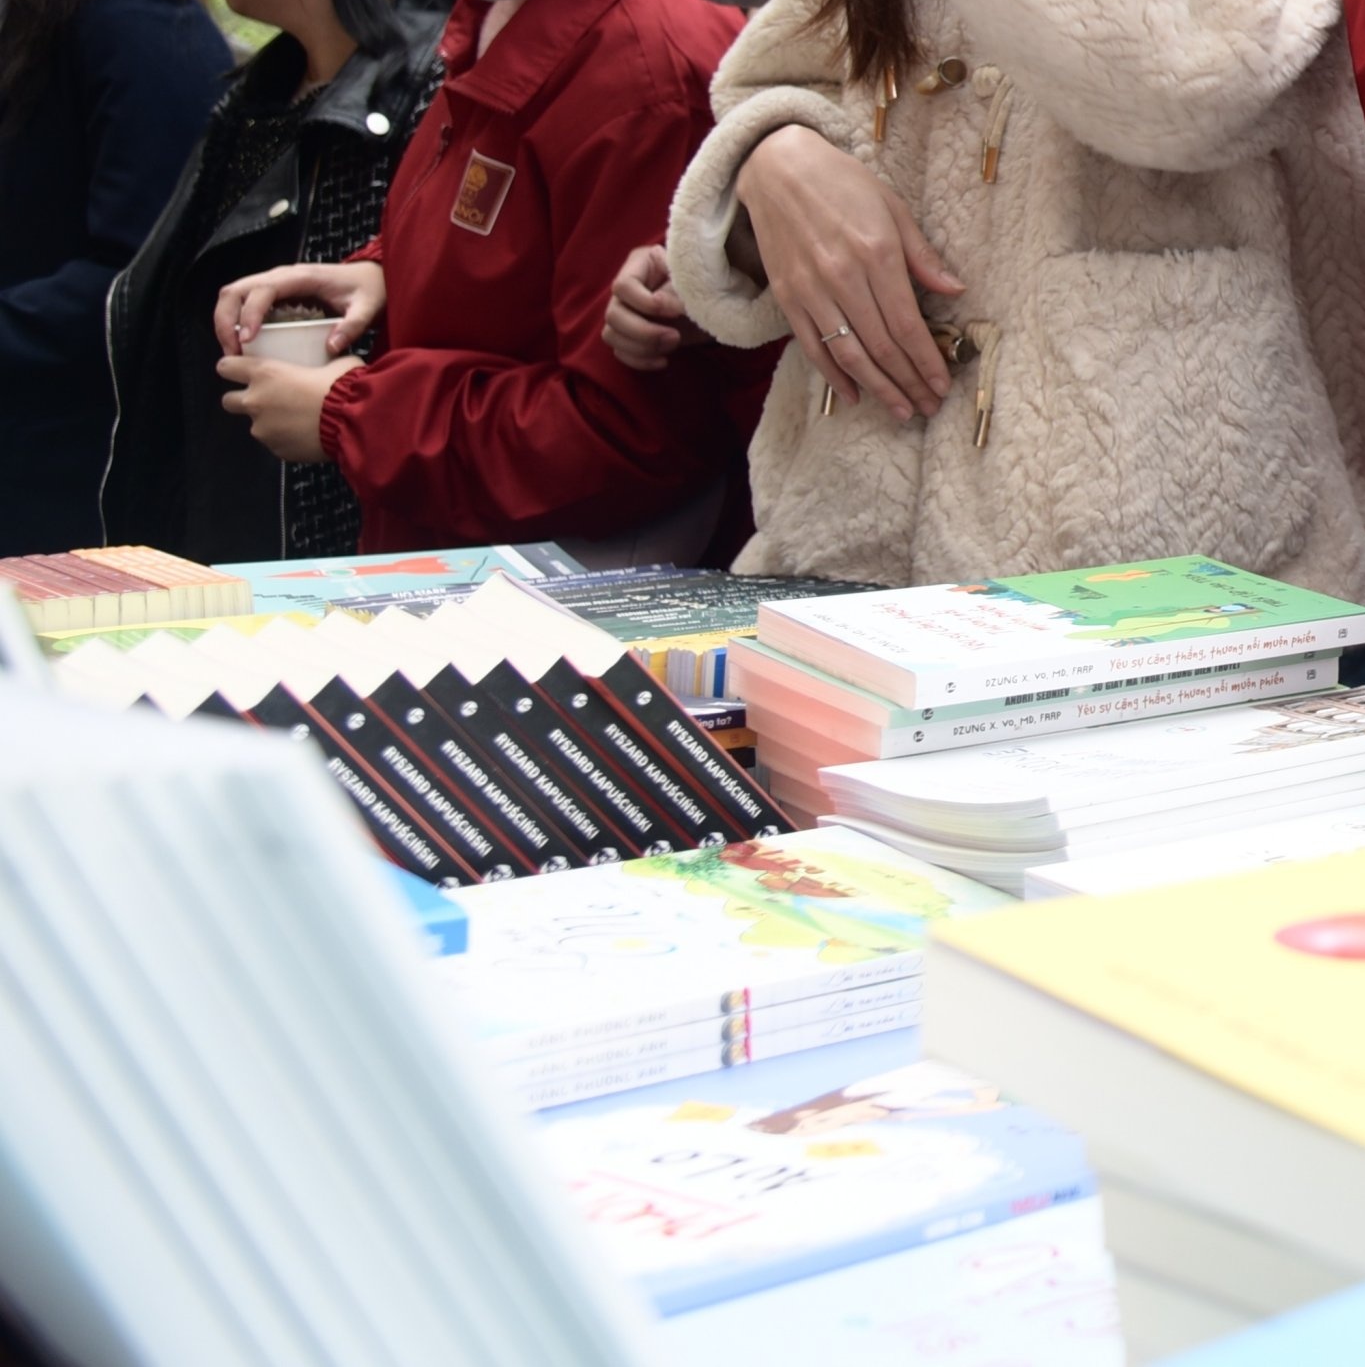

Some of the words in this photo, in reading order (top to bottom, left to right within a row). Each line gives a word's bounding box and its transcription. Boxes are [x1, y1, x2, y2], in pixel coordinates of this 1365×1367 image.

[986, 675, 1018, 687] DZUNG
[548, 727, 596, 775] RYSZARD
[602, 722, 649, 769] RYSZARD
[666, 719, 710, 764] RYSZARD
[953, 723, 987, 736] DZUNG
[381, 744, 432, 796] RYSZARD
[440, 738, 490, 789] RYSZARD
[493, 731, 541, 780] RYSZARD
[326, 755, 378, 808] RYSZARD
